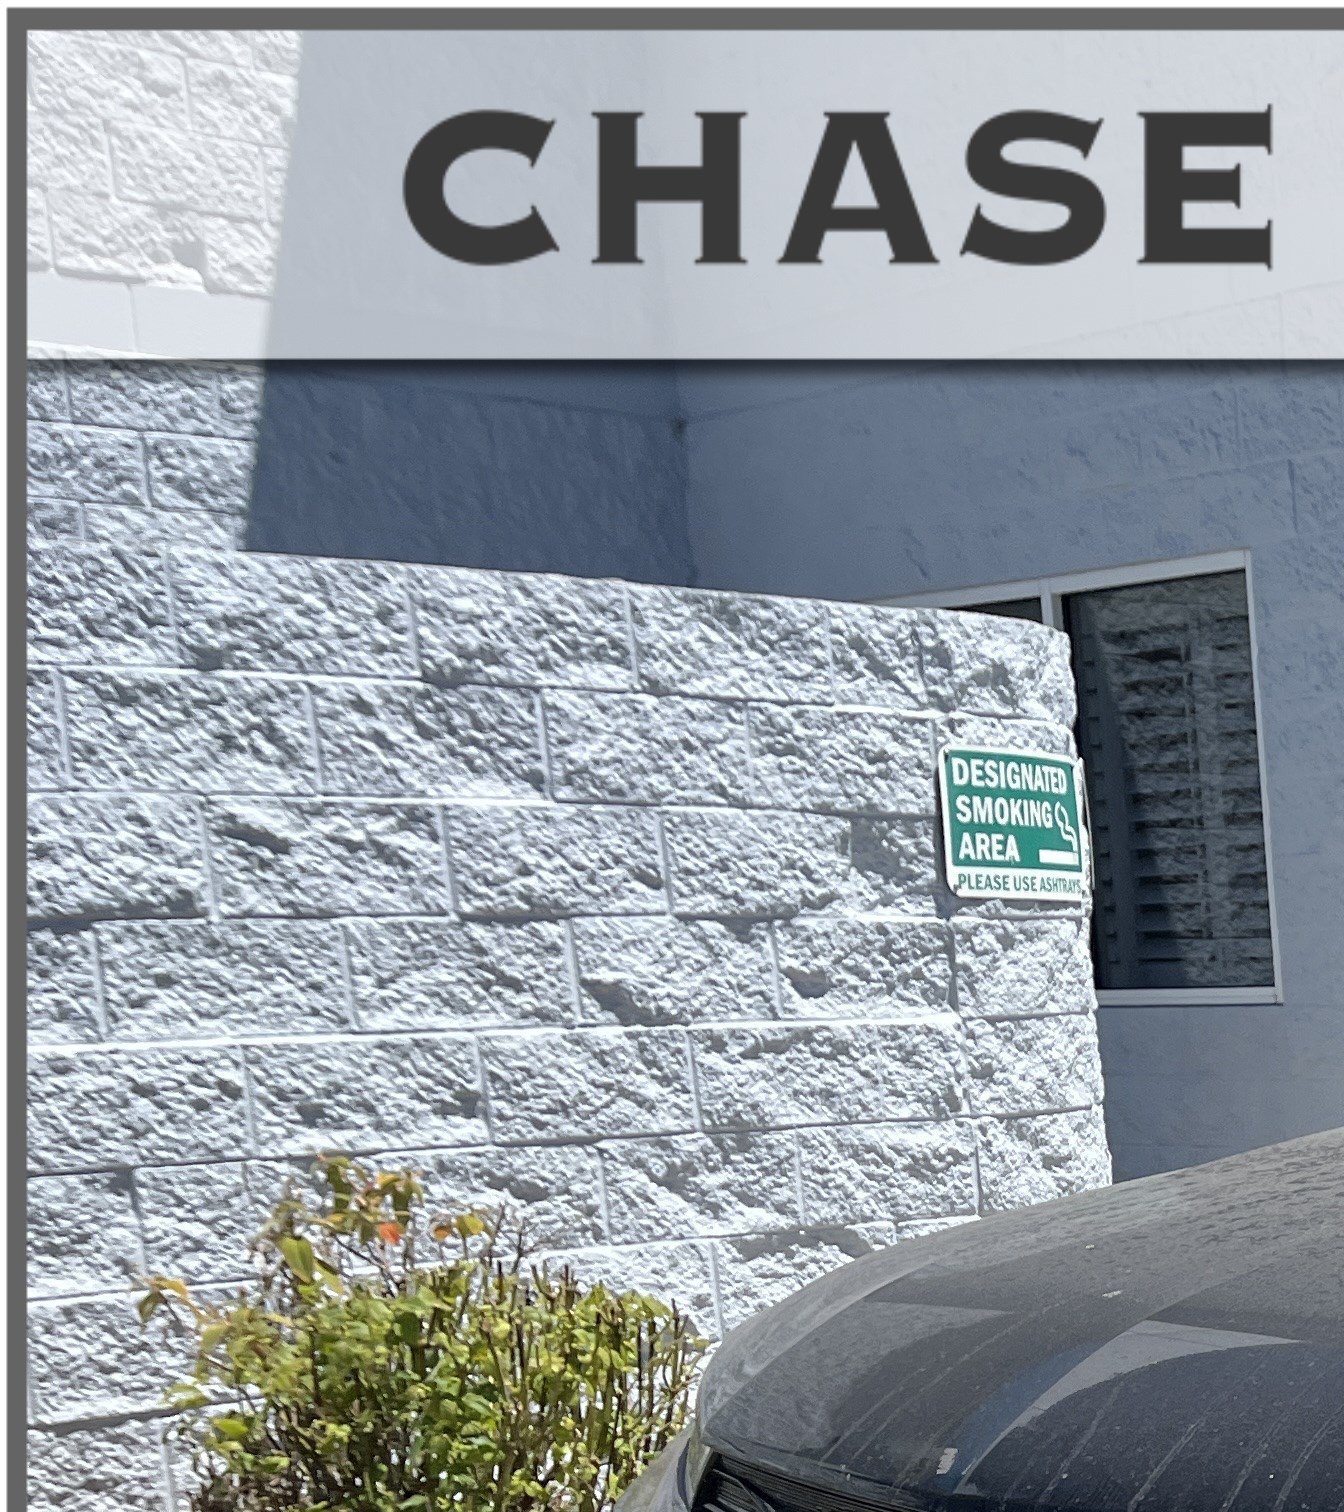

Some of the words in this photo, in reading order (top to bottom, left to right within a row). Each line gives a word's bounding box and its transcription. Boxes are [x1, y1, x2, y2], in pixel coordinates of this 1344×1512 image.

[951, 757, 1068, 795] DESIGNATED
[955, 795, 1054, 829] SMOKING
[958, 832, 1021, 862] AREA
[958, 873, 1011, 892] PLEASE
[1013, 875, 1038, 892] USE
[1039, 876, 1082, 894] ASHTRAYS
